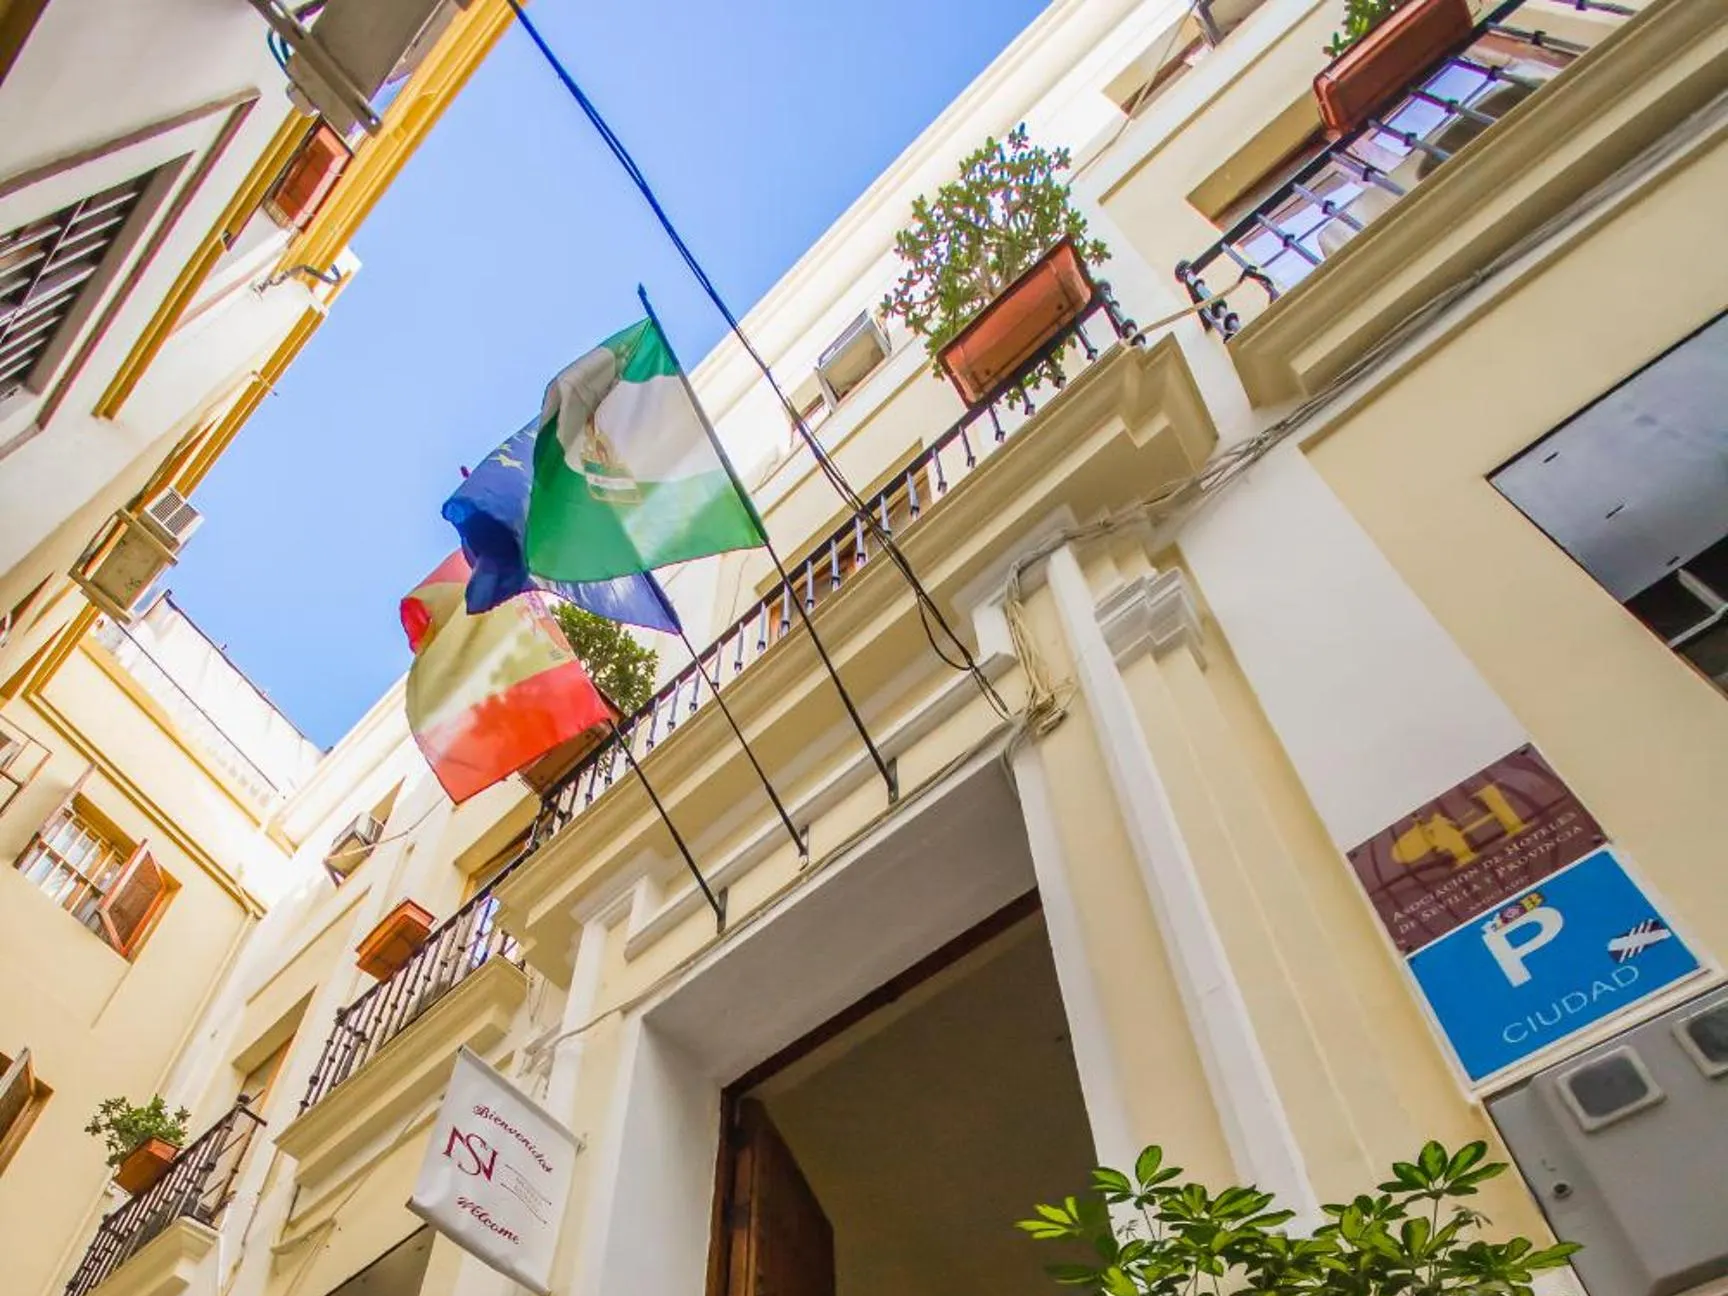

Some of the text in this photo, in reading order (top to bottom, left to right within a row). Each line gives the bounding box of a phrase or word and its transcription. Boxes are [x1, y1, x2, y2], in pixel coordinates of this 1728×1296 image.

[1420, 883, 1482, 922] SEVILLA
[1494, 825, 1584, 878] PROVINCIA
[1481, 904, 1564, 988] P
[1502, 964, 1640, 1044] CIUDAD
